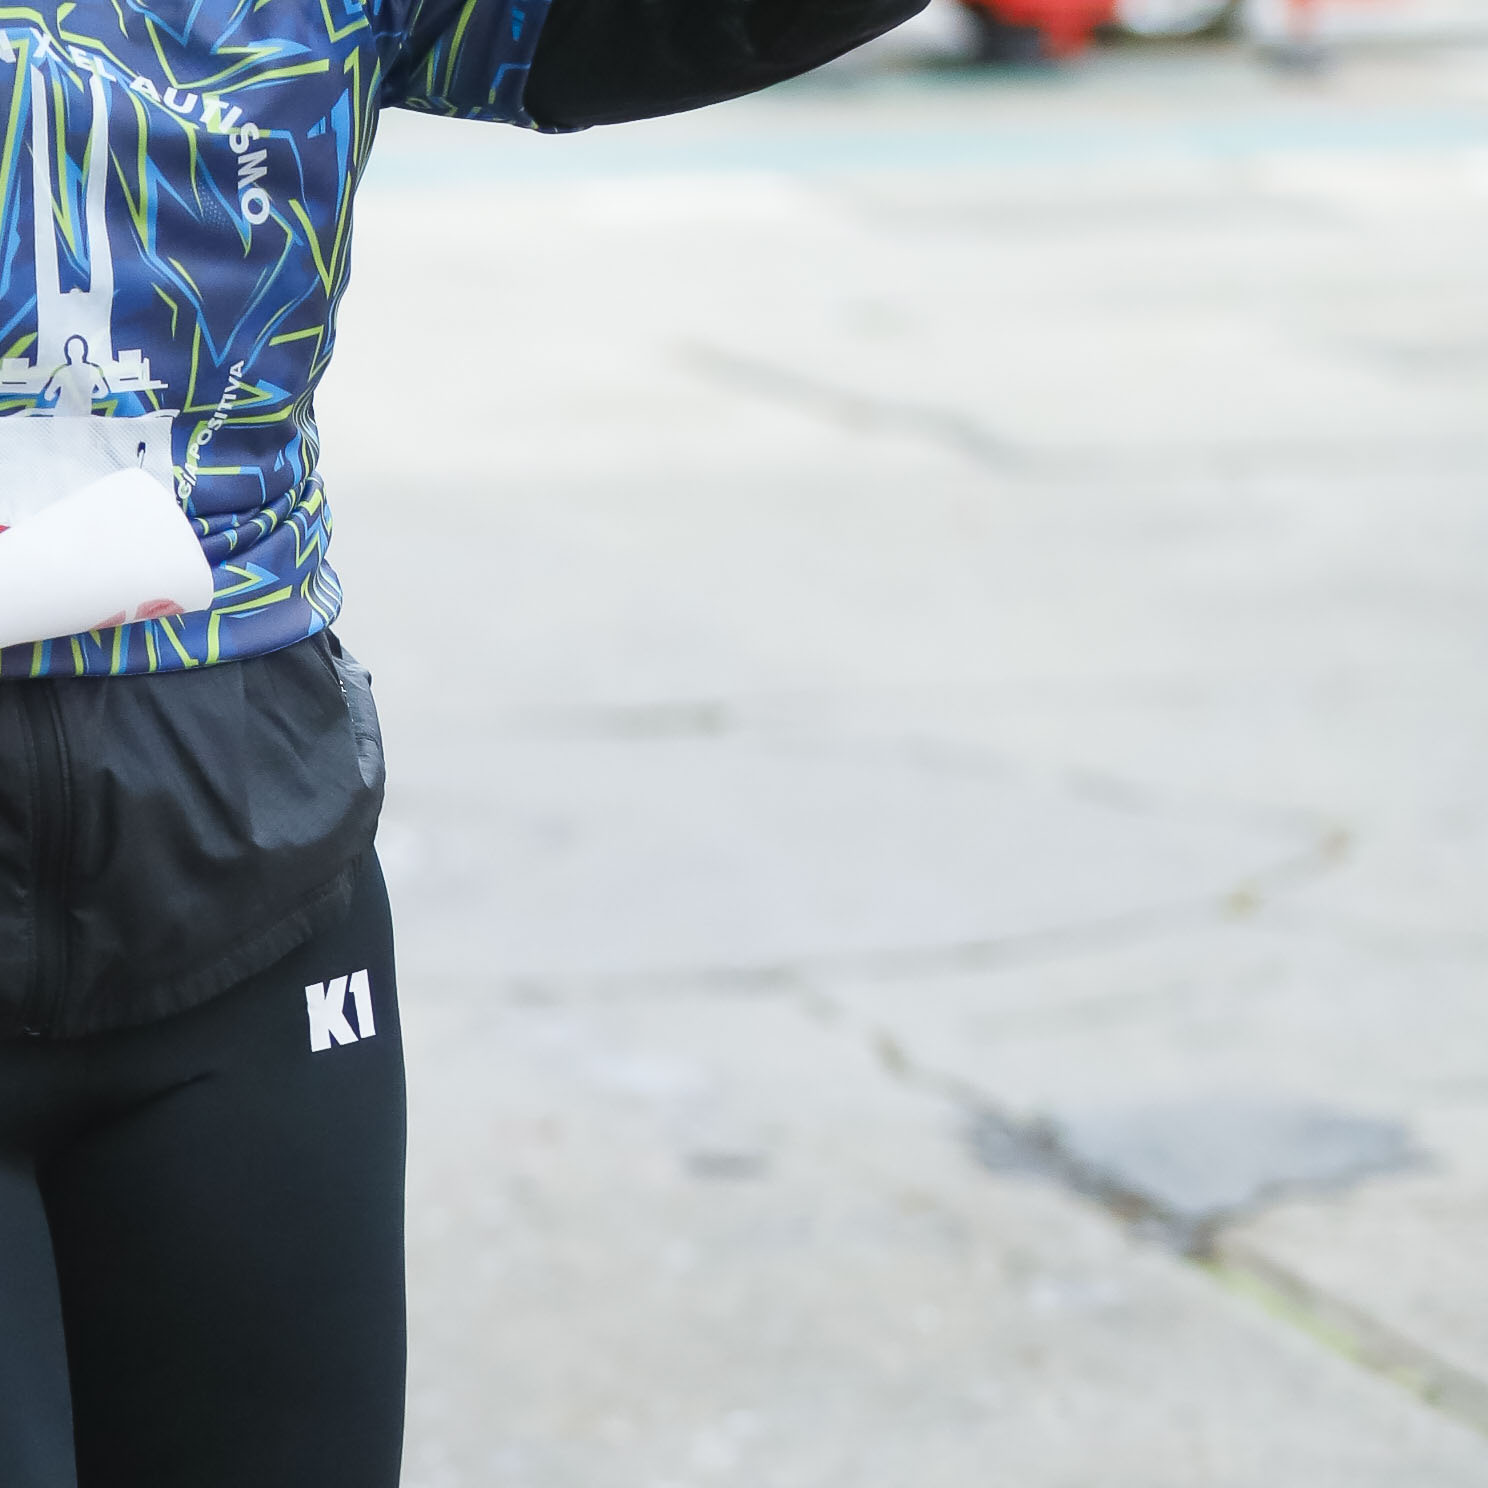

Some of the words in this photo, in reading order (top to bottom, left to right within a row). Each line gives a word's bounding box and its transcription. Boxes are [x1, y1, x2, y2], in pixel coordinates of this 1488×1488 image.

[29, 27, 61, 61] X
[68, 45, 116, 82] EL
[130, 75, 270, 225] AUTISMO
[189, 360, 244, 460] POSITIVA
[305, 968, 376, 1052] K1
